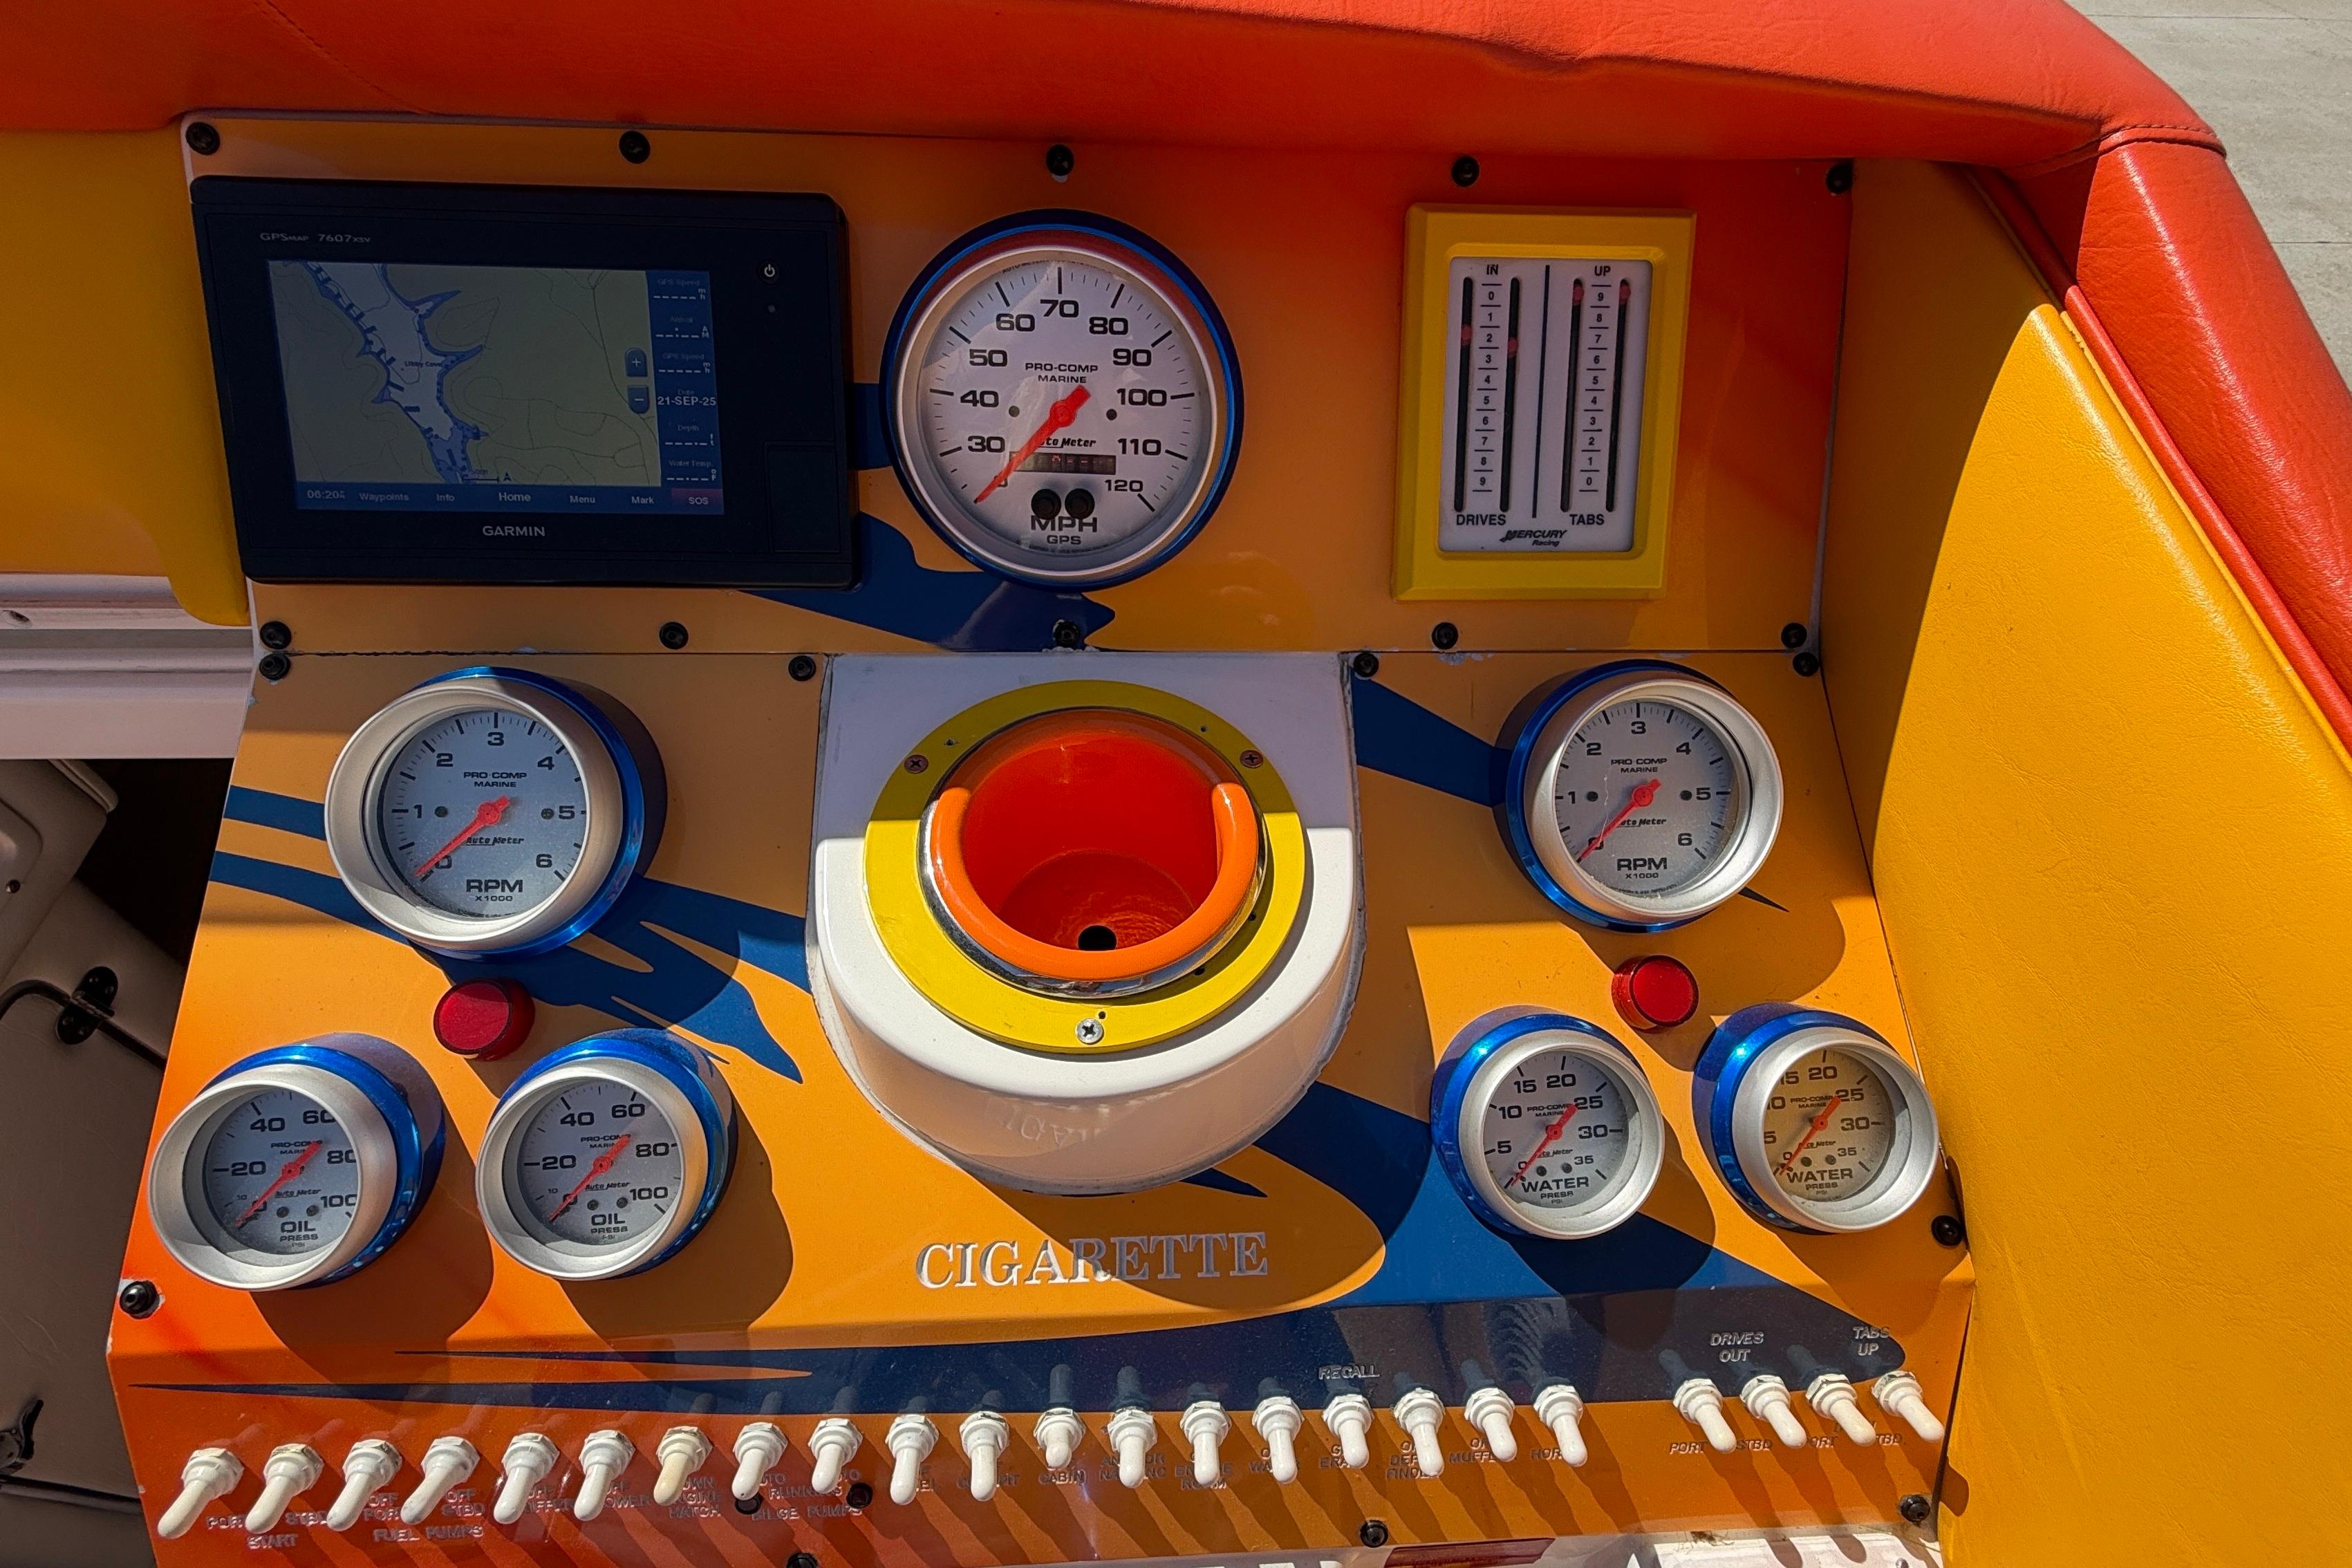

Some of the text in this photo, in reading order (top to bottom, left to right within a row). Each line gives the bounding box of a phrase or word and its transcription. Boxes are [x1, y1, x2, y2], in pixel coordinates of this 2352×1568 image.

[1486, 264, 1499, 276] IN
[1594, 266, 1612, 277] UP
[1488, 291, 1494, 300] 0
[1598, 292, 1604, 301] 9
[1040, 299, 1079, 318] 70
[996, 313, 1035, 332] 60
[1488, 312, 1493, 321] 1
[1596, 313, 1603, 322] 8
[1089, 317, 1128, 335] 80
[1486, 334, 1493, 343] 2
[1595, 335, 1601, 344] 7
[969, 348, 1008, 367] 50
[1113, 348, 1152, 366] 90
[1486, 355, 1491, 364] 3
[1594, 355, 1600, 364] 6
[1025, 362, 1099, 373] PRO-COMP
[1038, 374, 1087, 384] MARINE
[1484, 375, 1491, 384] 4
[1592, 376, 1598, 384] 5
[657, 396, 717, 406] 21-SEP-25
[960, 390, 999, 408] 40
[1117, 388, 1167, 407] 100
[1484, 396, 1490, 405] 5
[1591, 396, 1597, 404] 4
[1482, 417, 1488, 425] 6
[1590, 416, 1596, 425] 3
[968, 435, 1006, 454] 30
[1061, 438, 1097, 449] Meter
[1117, 438, 1161, 456] 110
[1482, 437, 1488, 445] 7
[1589, 437, 1595, 445] 2
[1481, 457, 1486, 465] 8
[1588, 457, 1592, 465] 1
[1104, 479, 1144, 493] 120
[1480, 477, 1486, 485] 9
[1587, 477, 1592, 485] 0
[359, 492, 409, 503] Waypoints
[436, 493, 455, 502] Info
[498, 492, 531, 503] Home
[570, 495, 596, 504] Menu
[631, 496, 655, 505] Mark
[688, 496, 709, 505] SOS
[1031, 515, 1098, 533] MPH
[1456, 514, 1506, 525] DRIVES
[1569, 514, 1605, 525] TABS
[483, 525, 545, 537] GARMIN
[1500, 530, 1567, 543] MERCURY
[1047, 534, 1081, 545] GPS
[1631, 721, 1646, 735] 3
[487, 731, 505, 747] 3
[1587, 743, 1602, 756] 2
[1676, 742, 1691, 755] 4
[436, 753, 454, 767] 2
[537, 756, 554, 770] 4
[1568, 791, 1576, 804] 1
[1696, 787, 1711, 801] 5
[413, 805, 422, 819] 1
[559, 805, 575, 820] 5
[1639, 819, 1667, 828] Meter
[492, 837, 525, 846] Meter
[1678, 832, 1692, 846] 6
[536, 853, 552, 868] 6
[1617, 857, 1668, 871] RPM
[466, 879, 523, 893] RPM
[1809, 1066, 1838, 1080] 20
[1513, 1080, 1537, 1094] 15
[1546, 1074, 1576, 1088] 20
[1836, 1088, 1864, 1102] 25
[1574, 1096, 1603, 1110] 25
[303, 1110, 336, 1124] 60
[611, 1103, 645, 1119] 60
[1498, 1105, 1522, 1119] 10
[250, 1117, 286, 1132] 40
[560, 1112, 595, 1127] 40
[1841, 1117, 1869, 1131] 30
[1578, 1125, 1608, 1139] 30
[635, 1143, 669, 1157] 80
[1497, 1141, 1512, 1154] 5
[1838, 1147, 1857, 1157] 35
[327, 1149, 356, 1164] 80
[542, 1155, 577, 1170] 20
[1574, 1155, 1594, 1165] 35
[232, 1161, 266, 1176] 20
[1786, 1168, 1853, 1184] WATER
[1521, 1176, 1589, 1193] WATER
[1806, 1182, 1838, 1191] PRESS
[630, 1186, 668, 1201] 100
[1540, 1191, 1574, 1200] PRESS
[321, 1194, 357, 1208] 100
[591, 1213, 626, 1226] OIL
[281, 1220, 316, 1233] OIL
[590, 1226, 628, 1234] PRESS
[279, 1233, 319, 1242] PRESS
[915, 1231, 1269, 1289] CIGARETTE
[1710, 1331, 1764, 1347] DRIVES
[1853, 1325, 1891, 1340] TABS
[1719, 1349, 1751, 1362] OUT
[1858, 1343, 1880, 1356] UP
[1318, 1364, 1381, 1380] RECALL
[1530, 1449, 1562, 1460] HOR
[1039, 1470, 1086, 1485] CABIN
[369, 1492, 399, 1507] OFF
[446, 1488, 476, 1503] OFF
[442, 1503, 484, 1517] STBD
[669, 1504, 721, 1519] HATCH
[207, 1515, 246, 1530] POR
[373, 1525, 483, 1542] FUEL PUMPS
[247, 1534, 299, 1549] START
